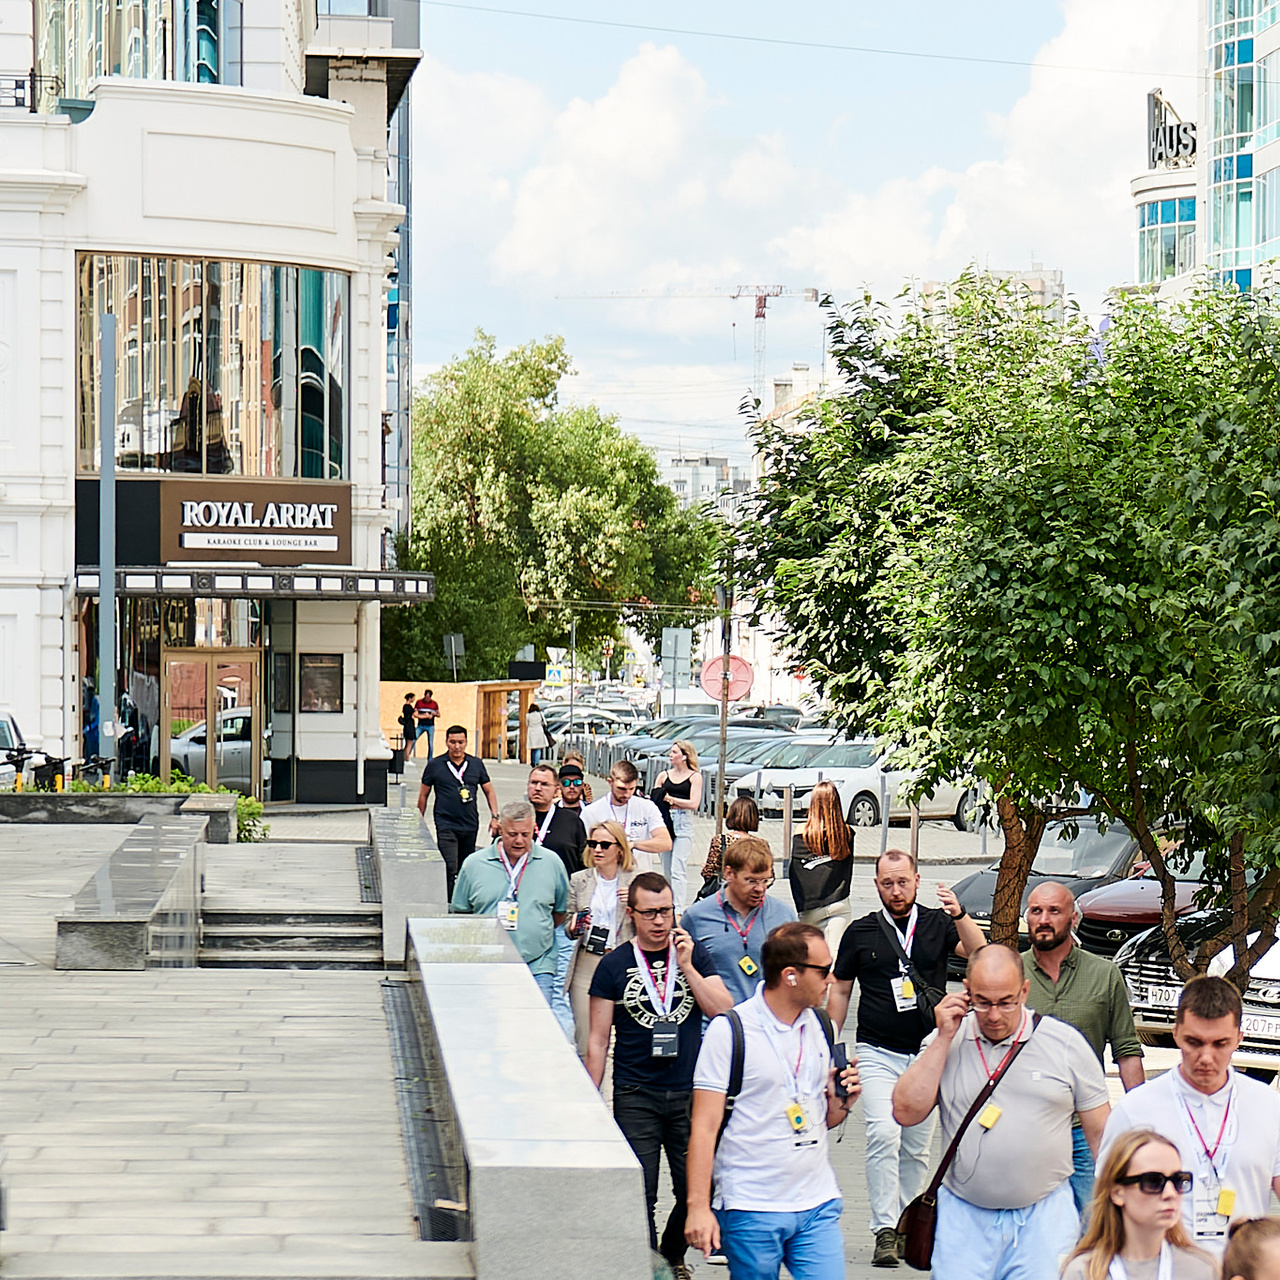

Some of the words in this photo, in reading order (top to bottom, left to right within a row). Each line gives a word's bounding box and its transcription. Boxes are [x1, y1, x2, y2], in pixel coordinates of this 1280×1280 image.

[182, 501, 260, 528] ROYAL
[262, 502, 338, 529] ARBAT
[207, 538, 241, 546] KARAOKE
[244, 538, 262, 546] CLUB
[272, 539, 302, 547] LOUNGE
[304, 539, 318, 547] BAR
